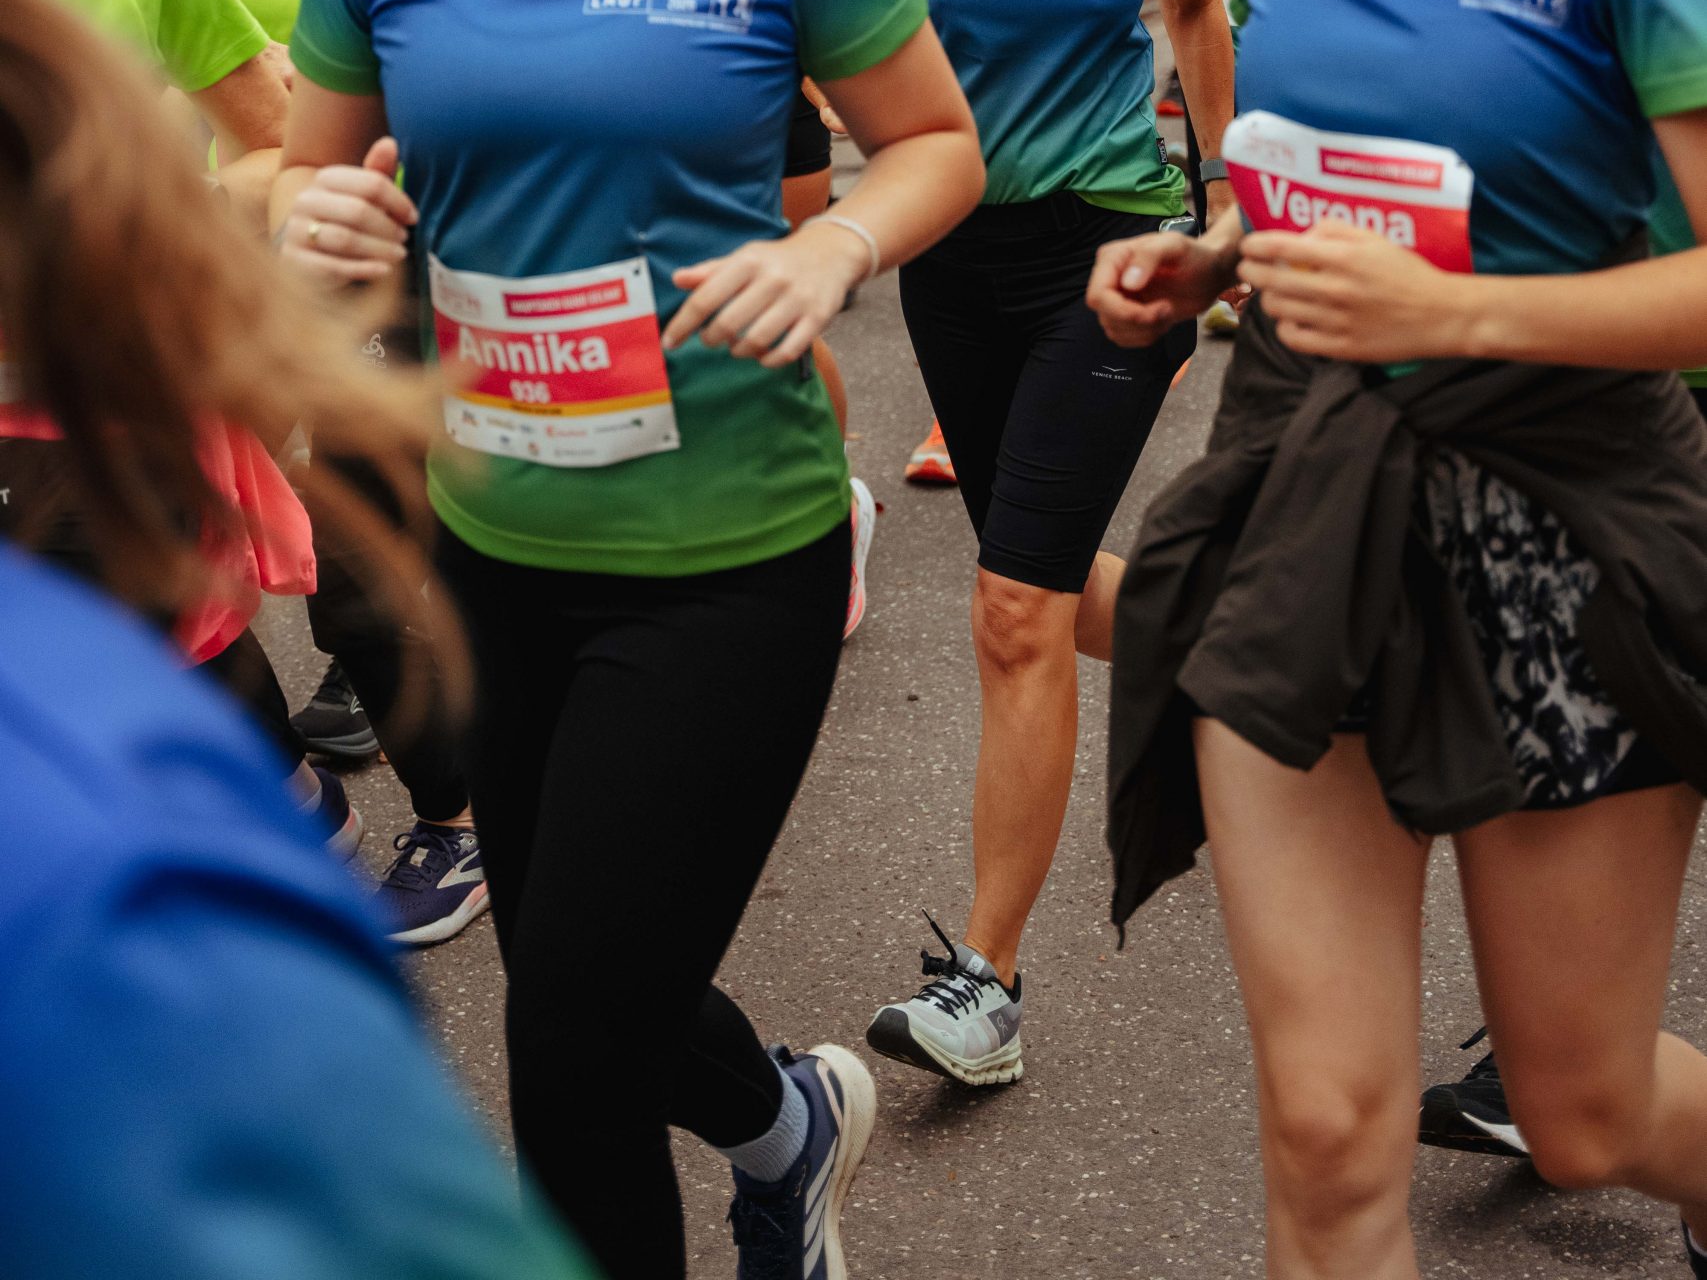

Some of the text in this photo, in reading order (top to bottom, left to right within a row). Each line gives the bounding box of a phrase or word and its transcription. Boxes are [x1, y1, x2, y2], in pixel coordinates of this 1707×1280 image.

[457, 324, 609, 375] Annika
[1091, 371, 1112, 379] VENICE
[509, 380, 550, 404] 936
